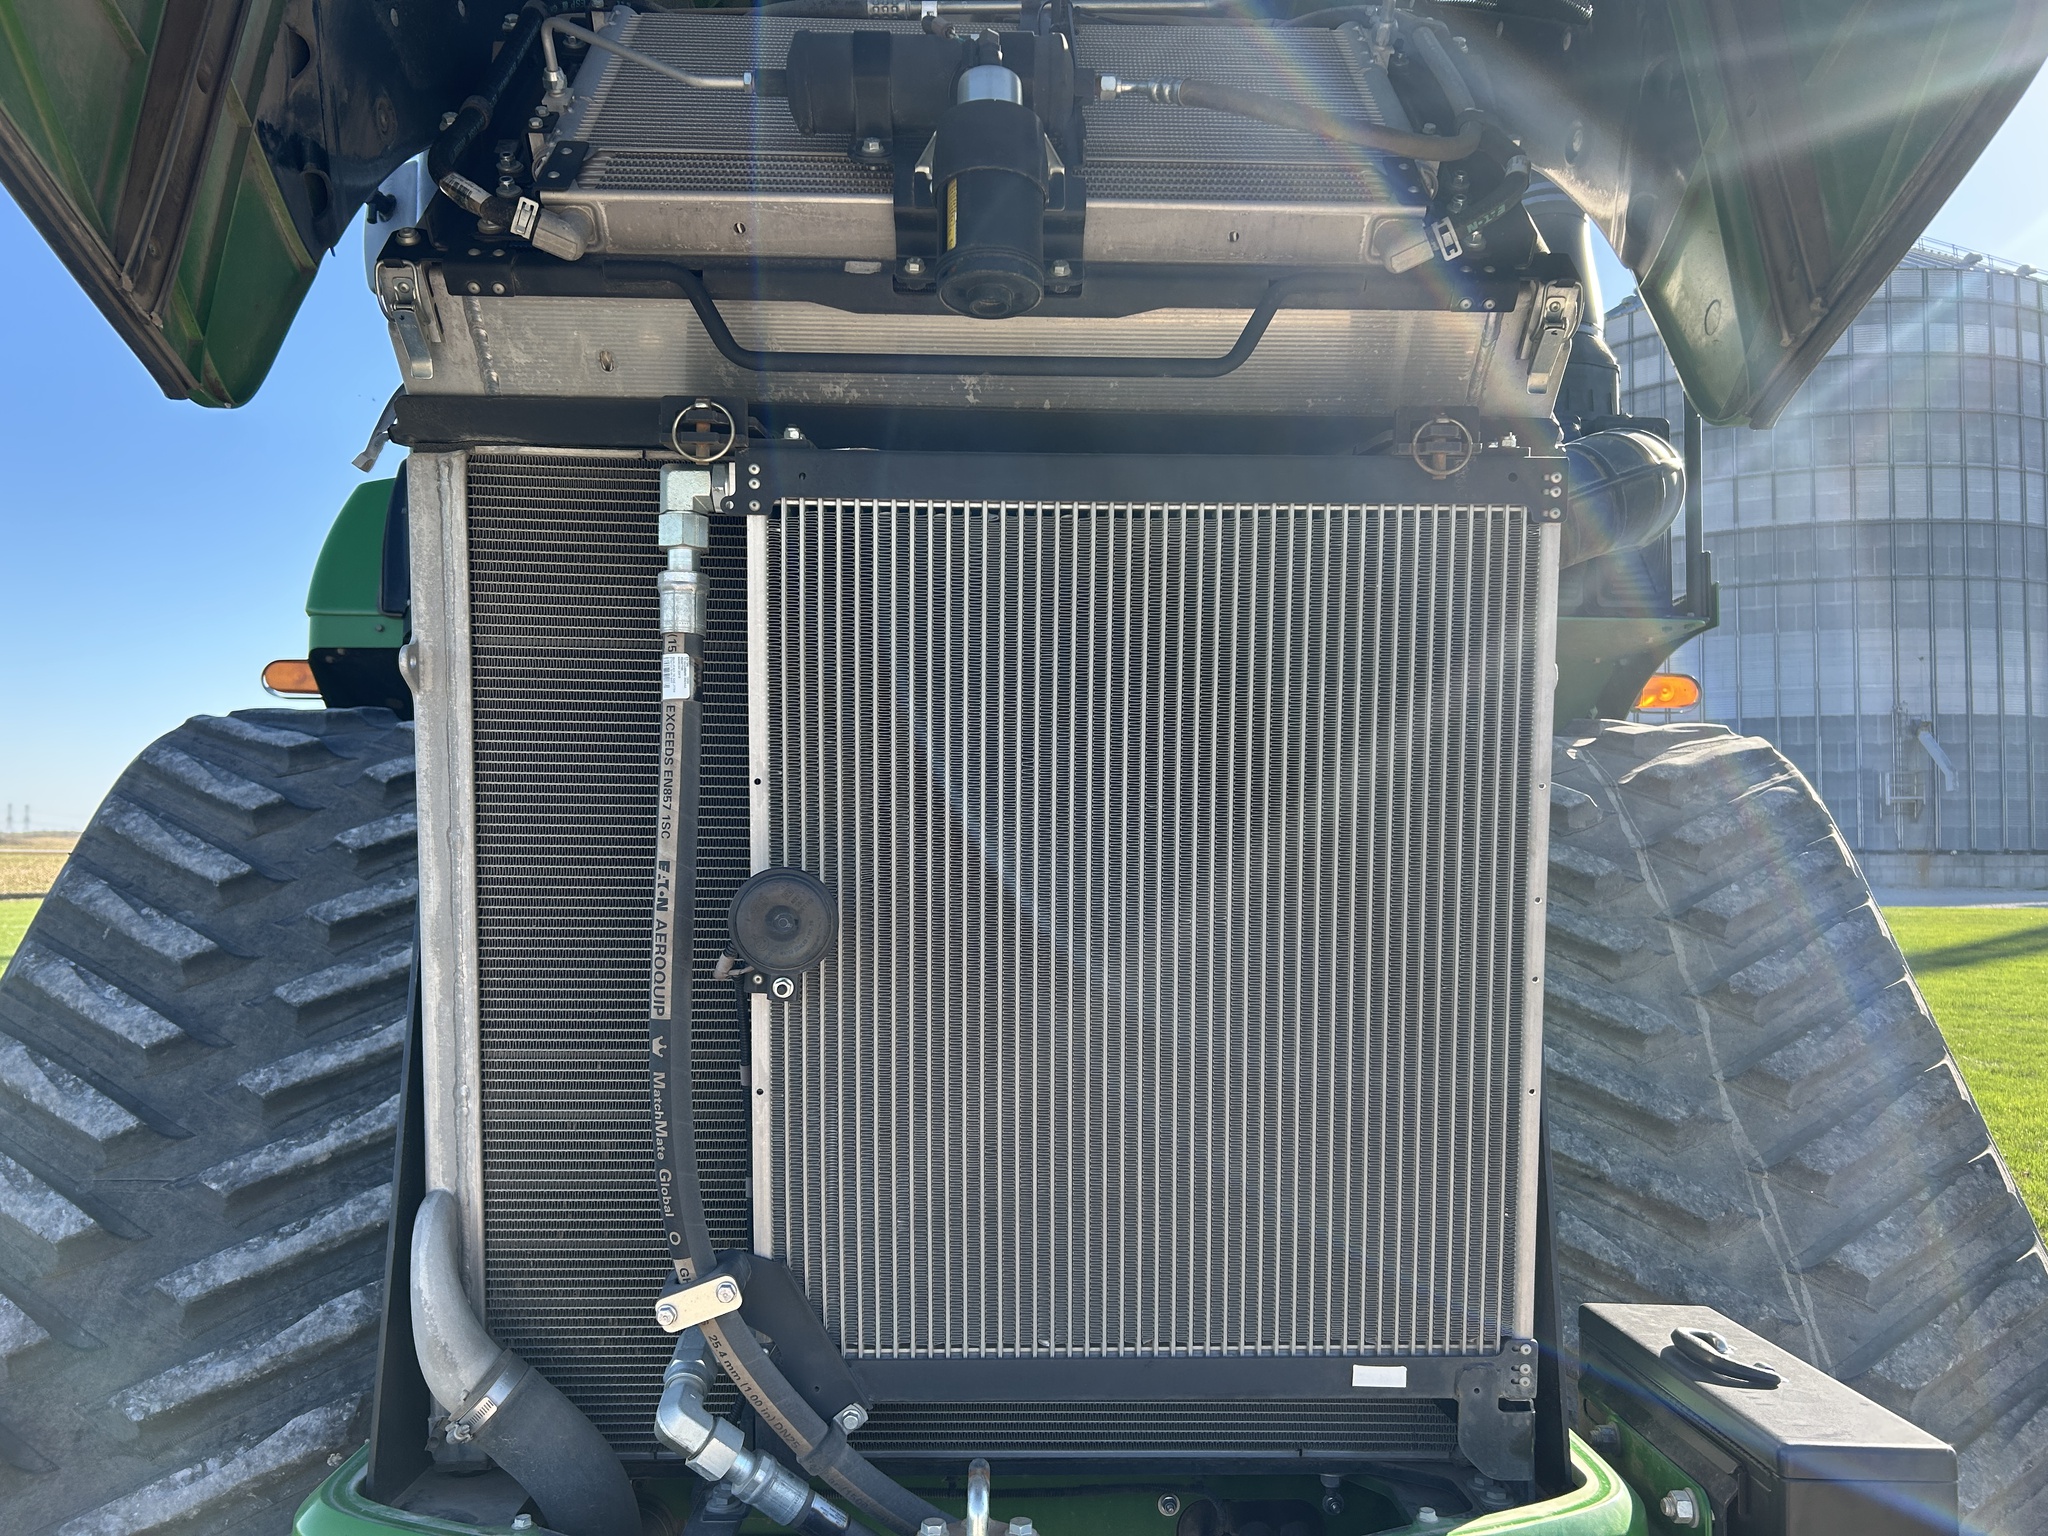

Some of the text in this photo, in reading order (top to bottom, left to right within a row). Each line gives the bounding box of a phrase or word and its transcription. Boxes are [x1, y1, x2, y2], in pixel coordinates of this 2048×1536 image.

[664, 705, 676, 766] EXCEEDS
[662, 770, 674, 811] EN857
[661, 815, 671, 839] 1SC
[653, 919, 668, 1017] AEROQUIP
[653, 1072, 668, 1160] MatchMate
[659, 1168, 675, 1217] Global
[708, 1334, 801, 1449] 25.4 mm (100 in) DN25
